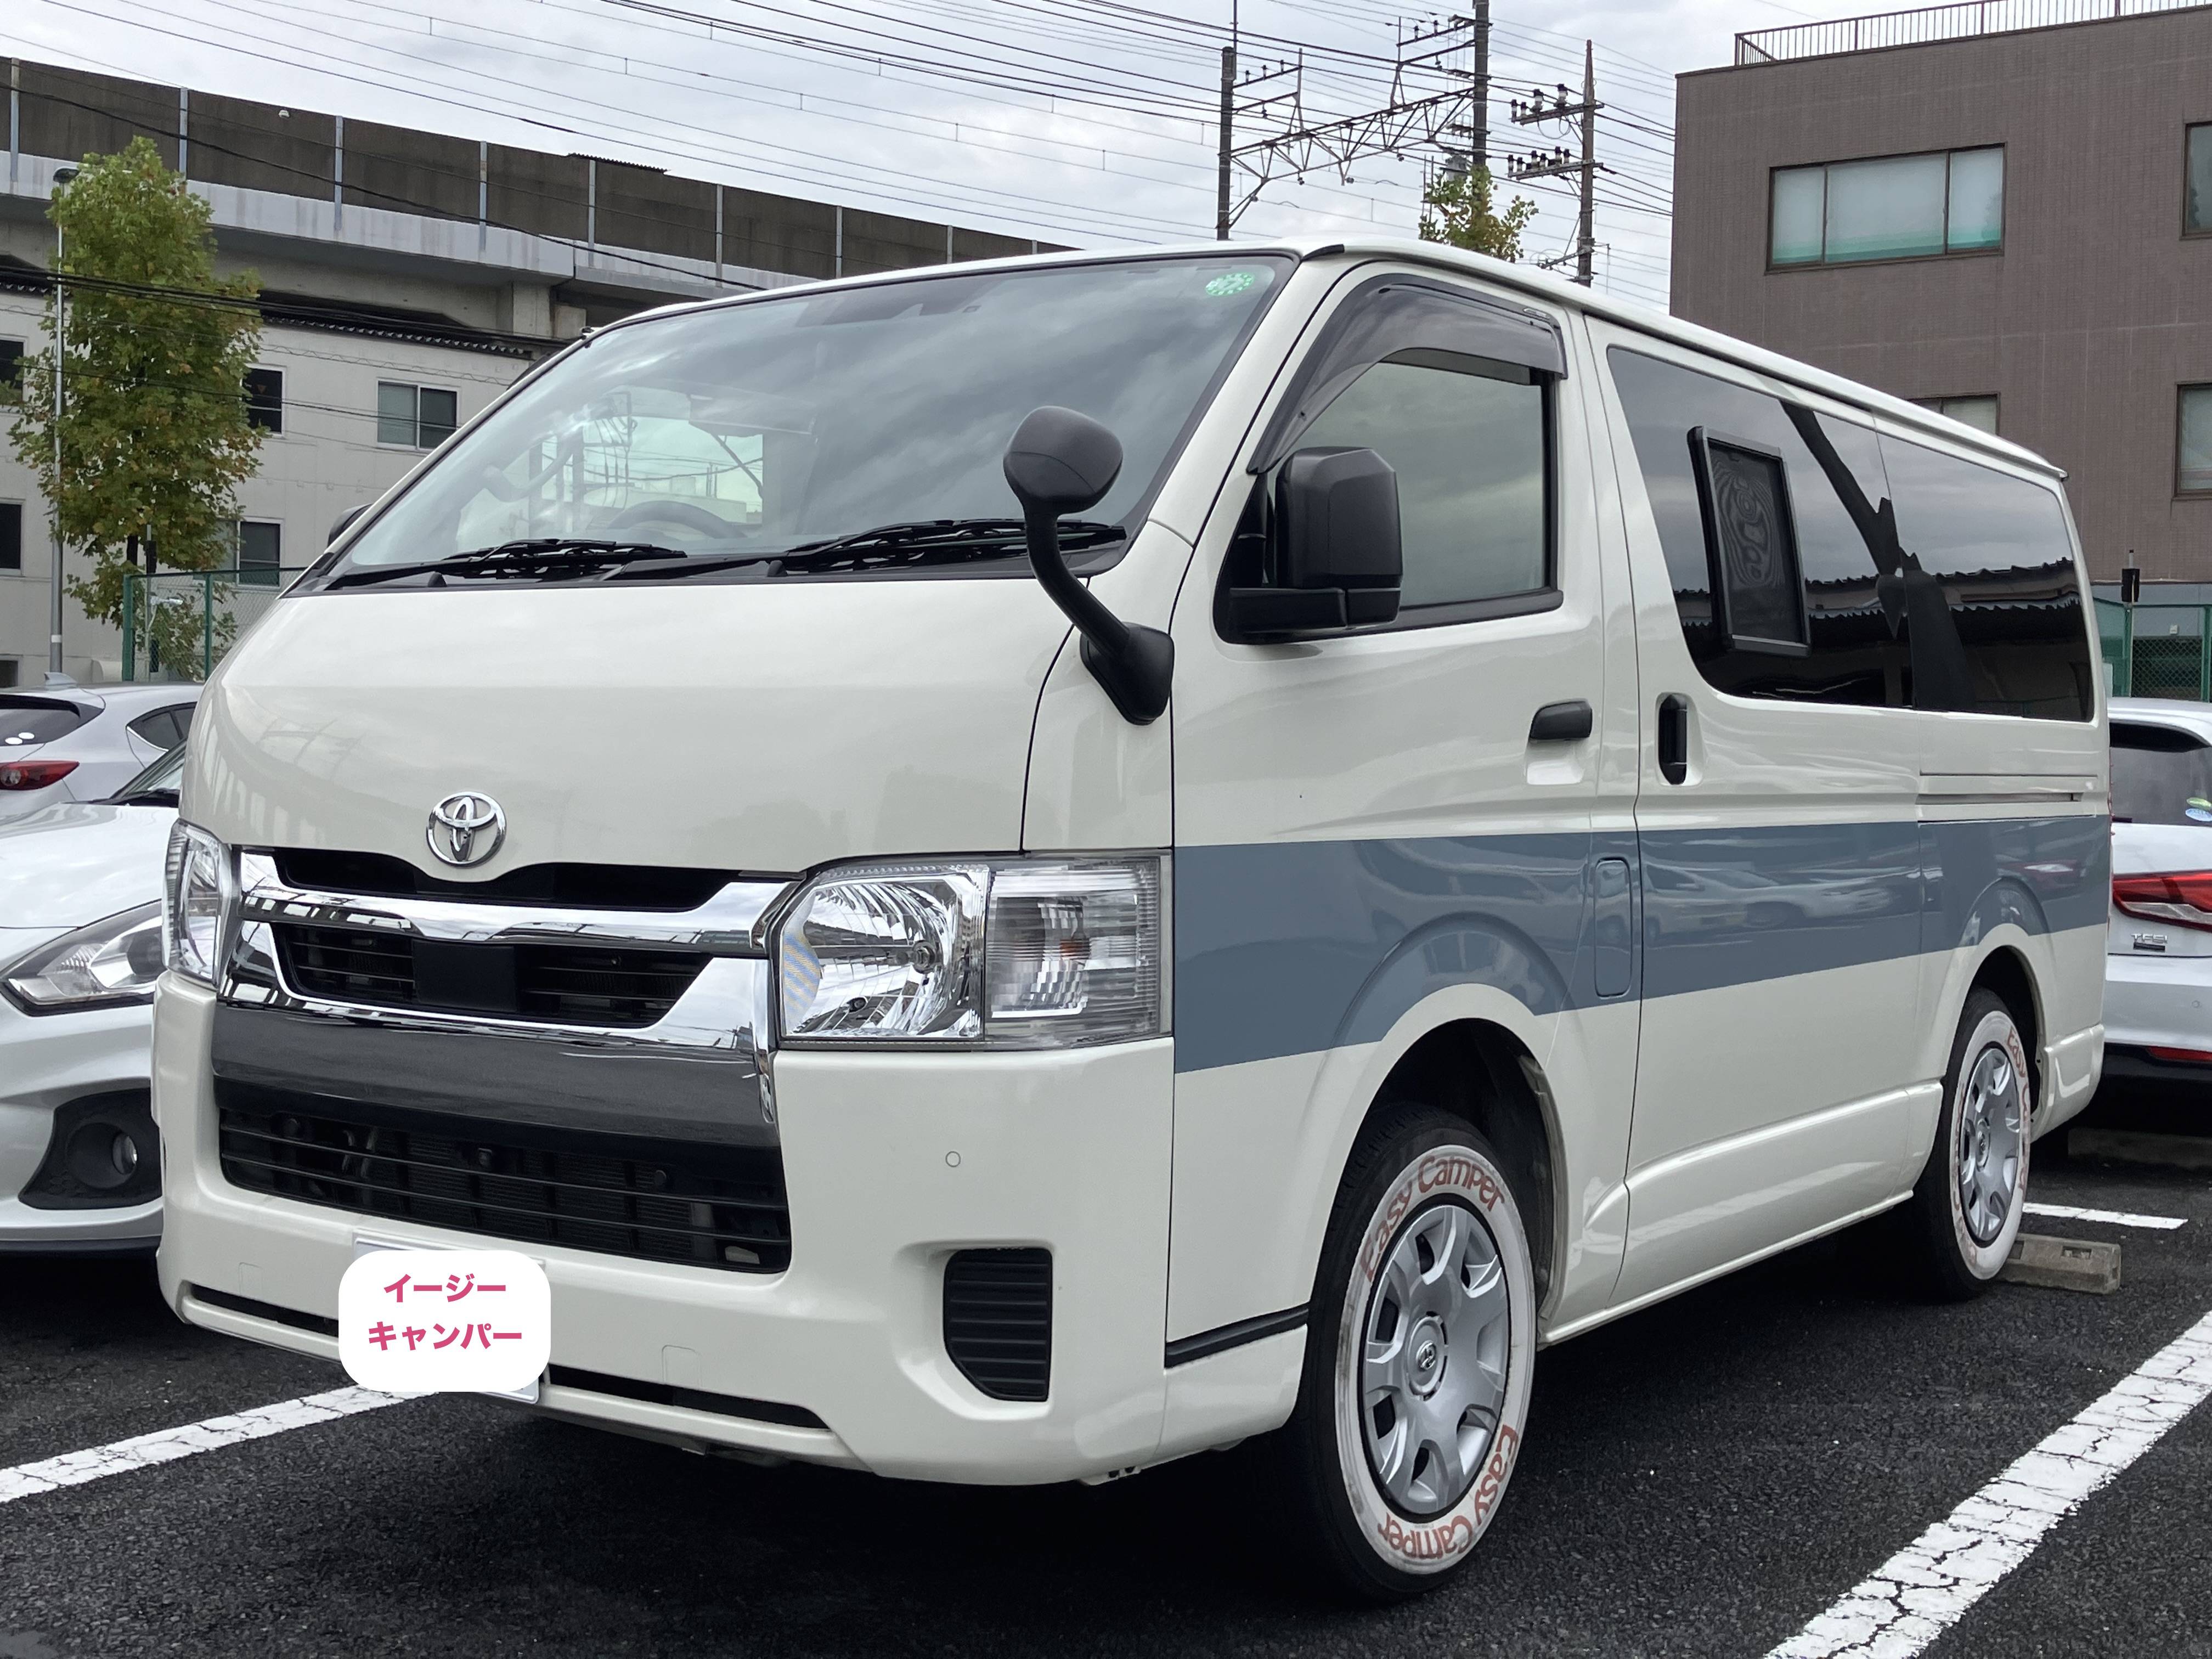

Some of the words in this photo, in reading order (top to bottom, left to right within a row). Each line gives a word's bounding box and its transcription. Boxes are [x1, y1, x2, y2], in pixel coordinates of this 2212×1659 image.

[1359, 1181, 1413, 1283] Easy
[1417, 1155, 1505, 1212] Camper
[1475, 1424, 1519, 1525] Easy
[1377, 1513, 1473, 1560] Camper
